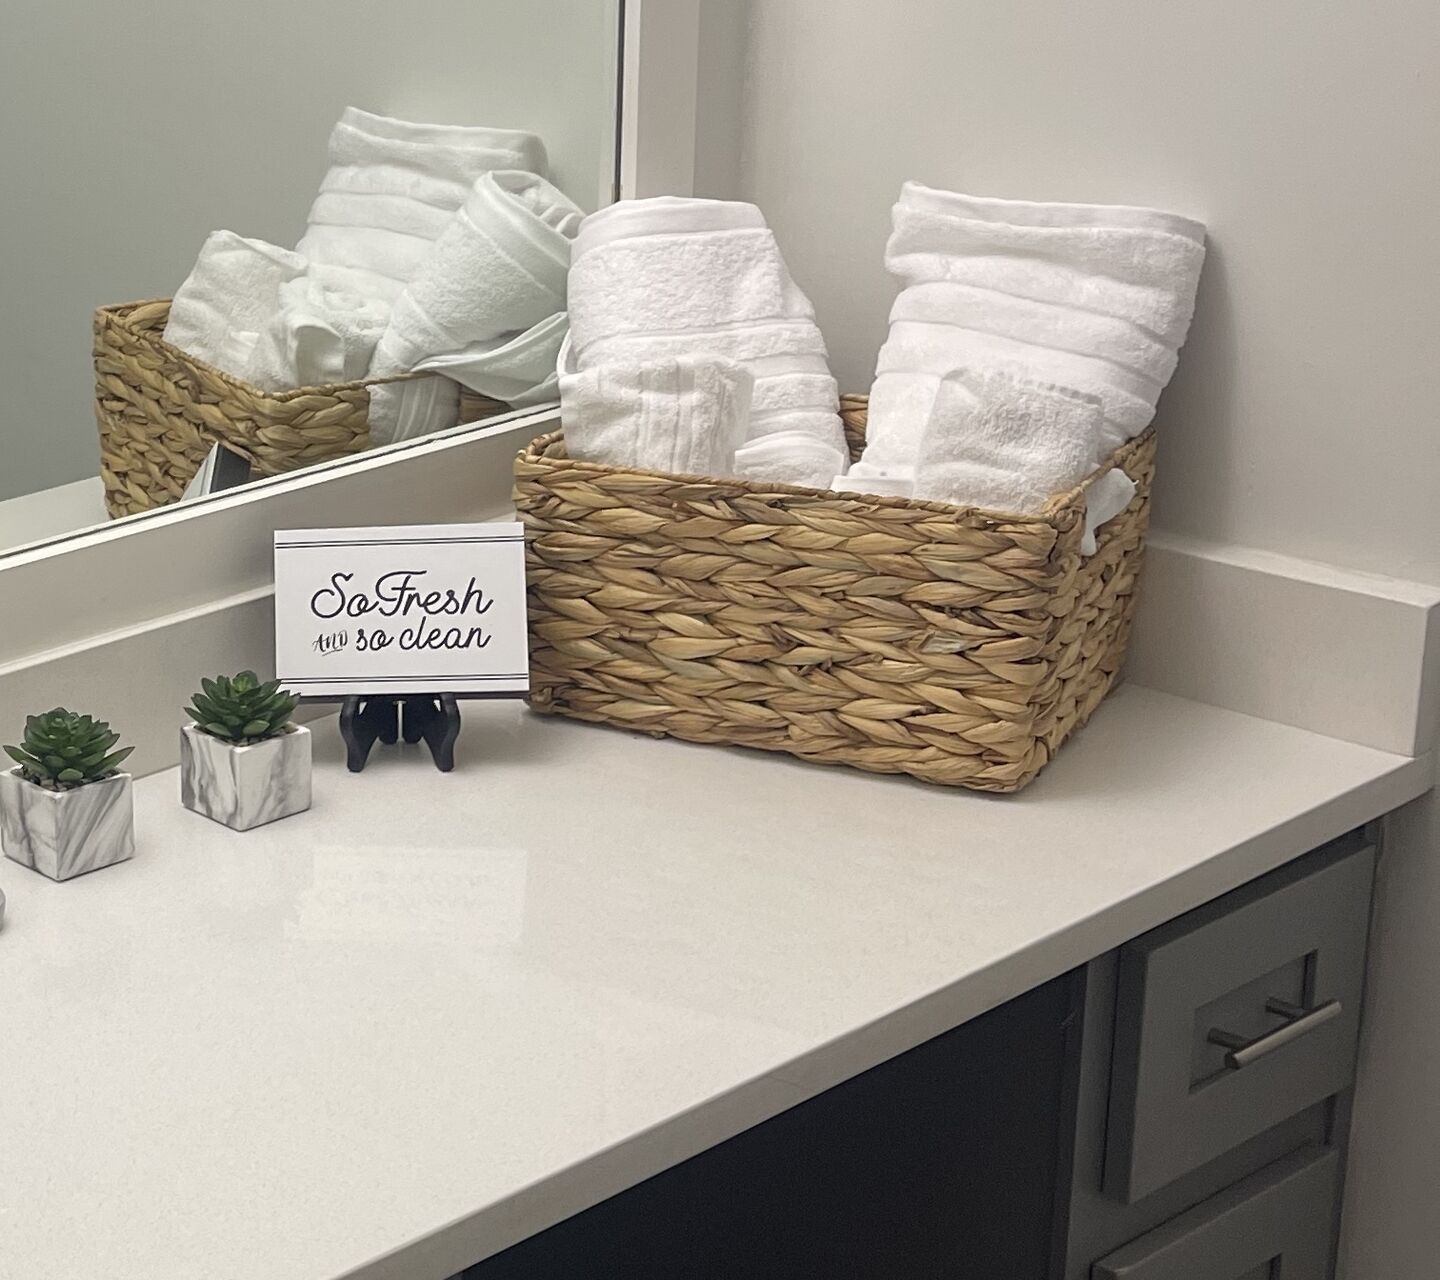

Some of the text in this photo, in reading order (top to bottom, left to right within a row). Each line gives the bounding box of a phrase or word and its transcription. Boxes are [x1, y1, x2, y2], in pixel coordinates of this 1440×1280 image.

[311, 570, 494, 618] So Fresh
[356, 628, 394, 650] so
[399, 616, 491, 650] clean
